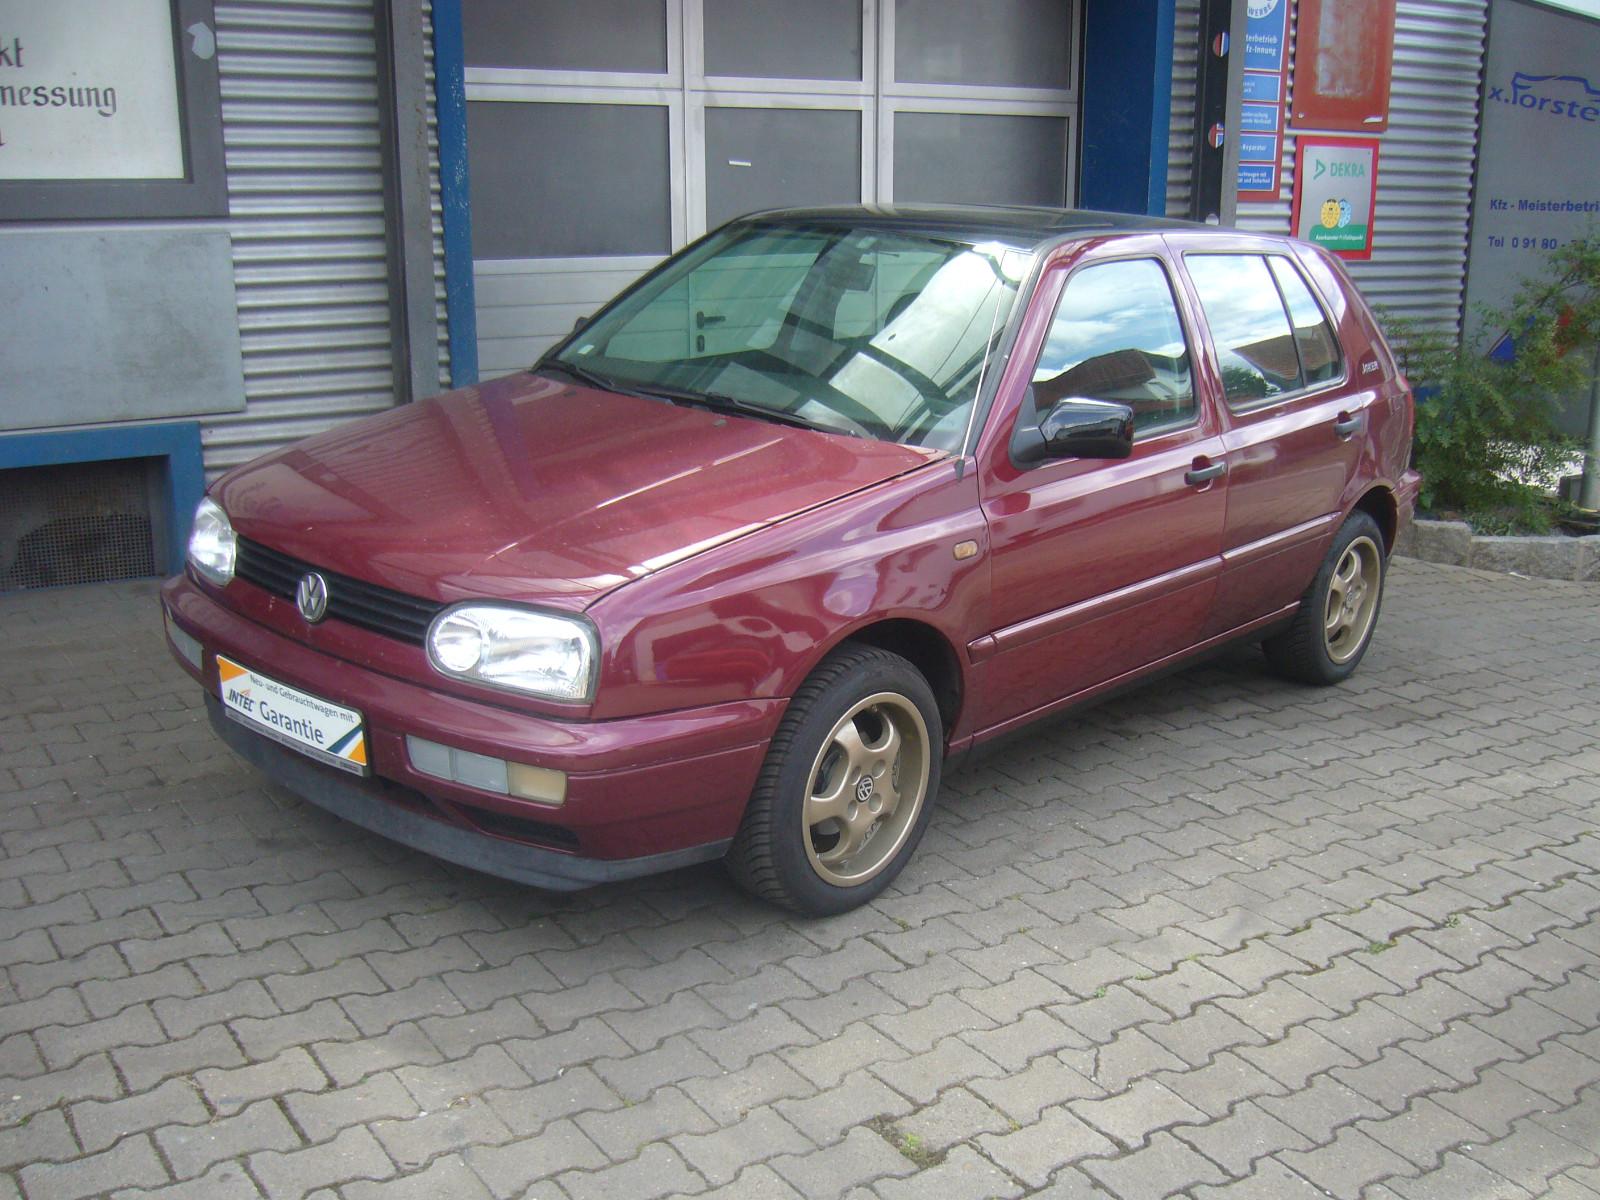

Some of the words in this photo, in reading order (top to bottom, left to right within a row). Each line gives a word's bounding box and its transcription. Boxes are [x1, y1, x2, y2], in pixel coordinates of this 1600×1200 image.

[1330, 162, 1365, 177] DEKRA
[1490, 199, 1508, 210] Kfz
[265, 683, 279, 695] und
[279, 687, 339, 719] Gebrauchtwagen
[339, 711, 355, 723] mit
[228, 689, 256, 712] INTEC
[259, 700, 325, 745] Garantie
